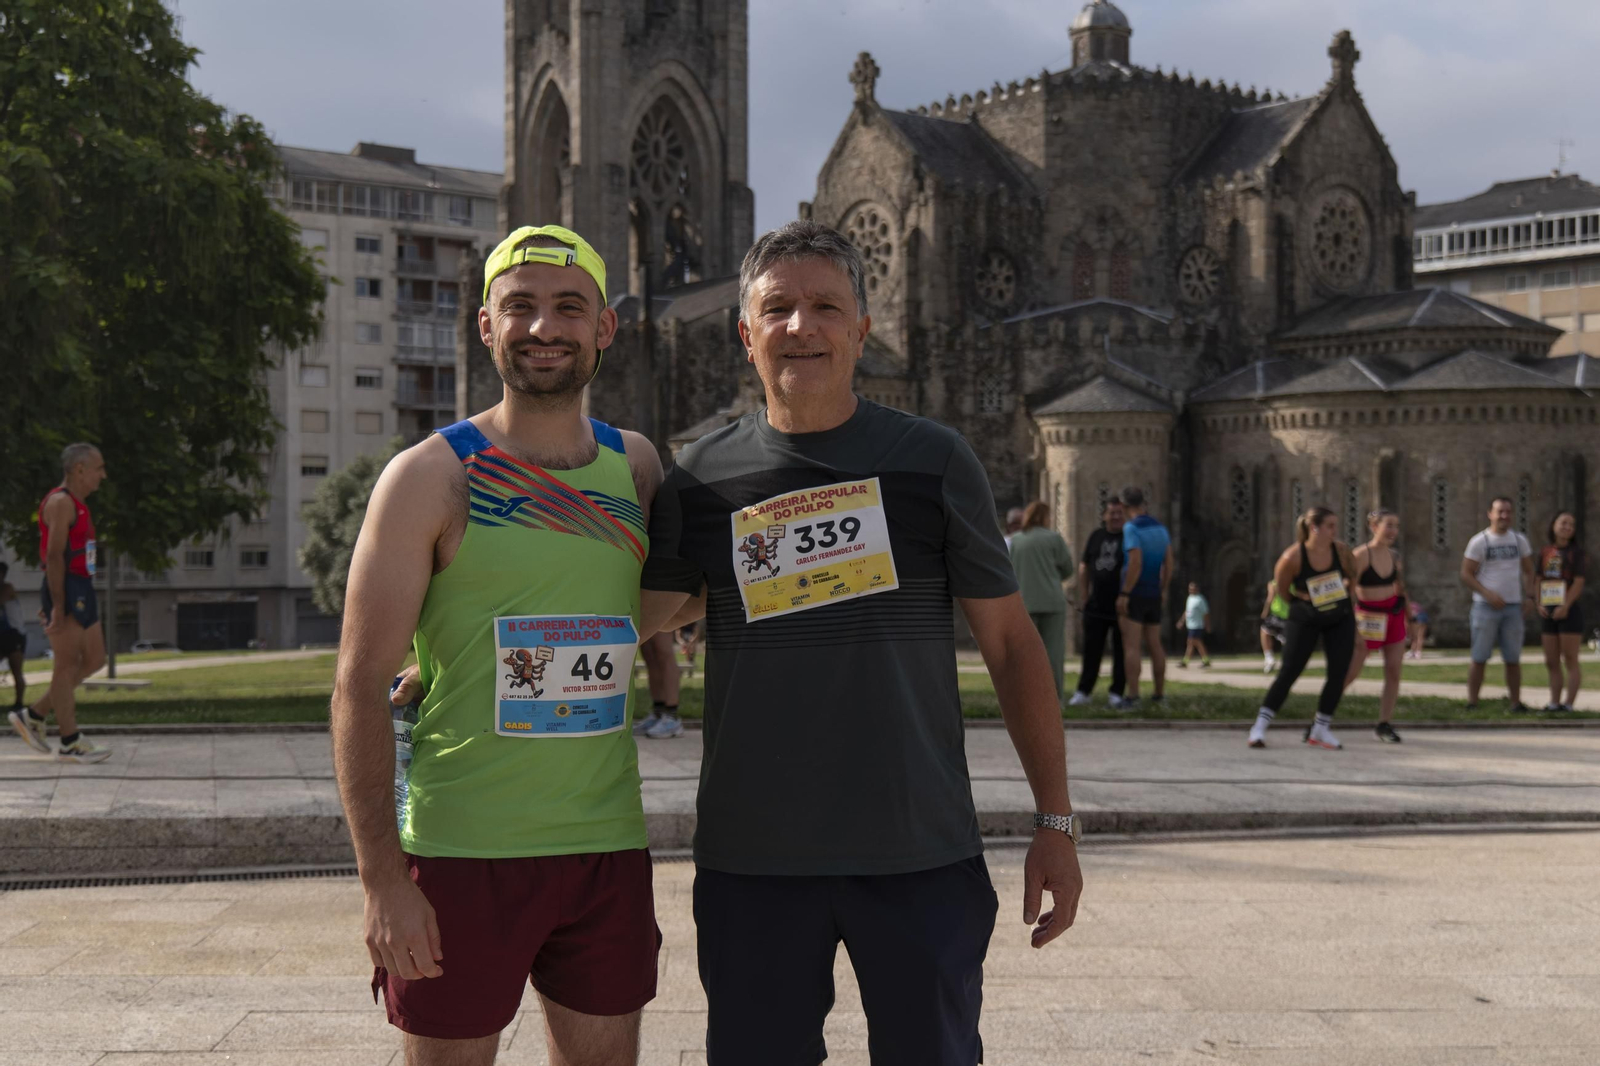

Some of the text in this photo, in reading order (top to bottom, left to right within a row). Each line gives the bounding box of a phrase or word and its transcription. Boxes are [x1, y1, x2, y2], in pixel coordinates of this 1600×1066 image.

[751, 495, 808, 517] CARREIRA
[810, 484, 867, 501] POPULAR
[774, 500, 834, 521] DO PULPO
[794, 517, 861, 554] 339
[796, 543, 866, 565] CARLOS FERNANDEZ GAY
[790, 593, 810, 602] VITAMIN
[830, 587, 850, 596] NOCCO
[508, 618, 626, 632] II CARREIRA POPULAR
[544, 630, 601, 641] DO PULPO
[571, 652, 613, 681] 46
[504, 722, 532, 730] GADIS
